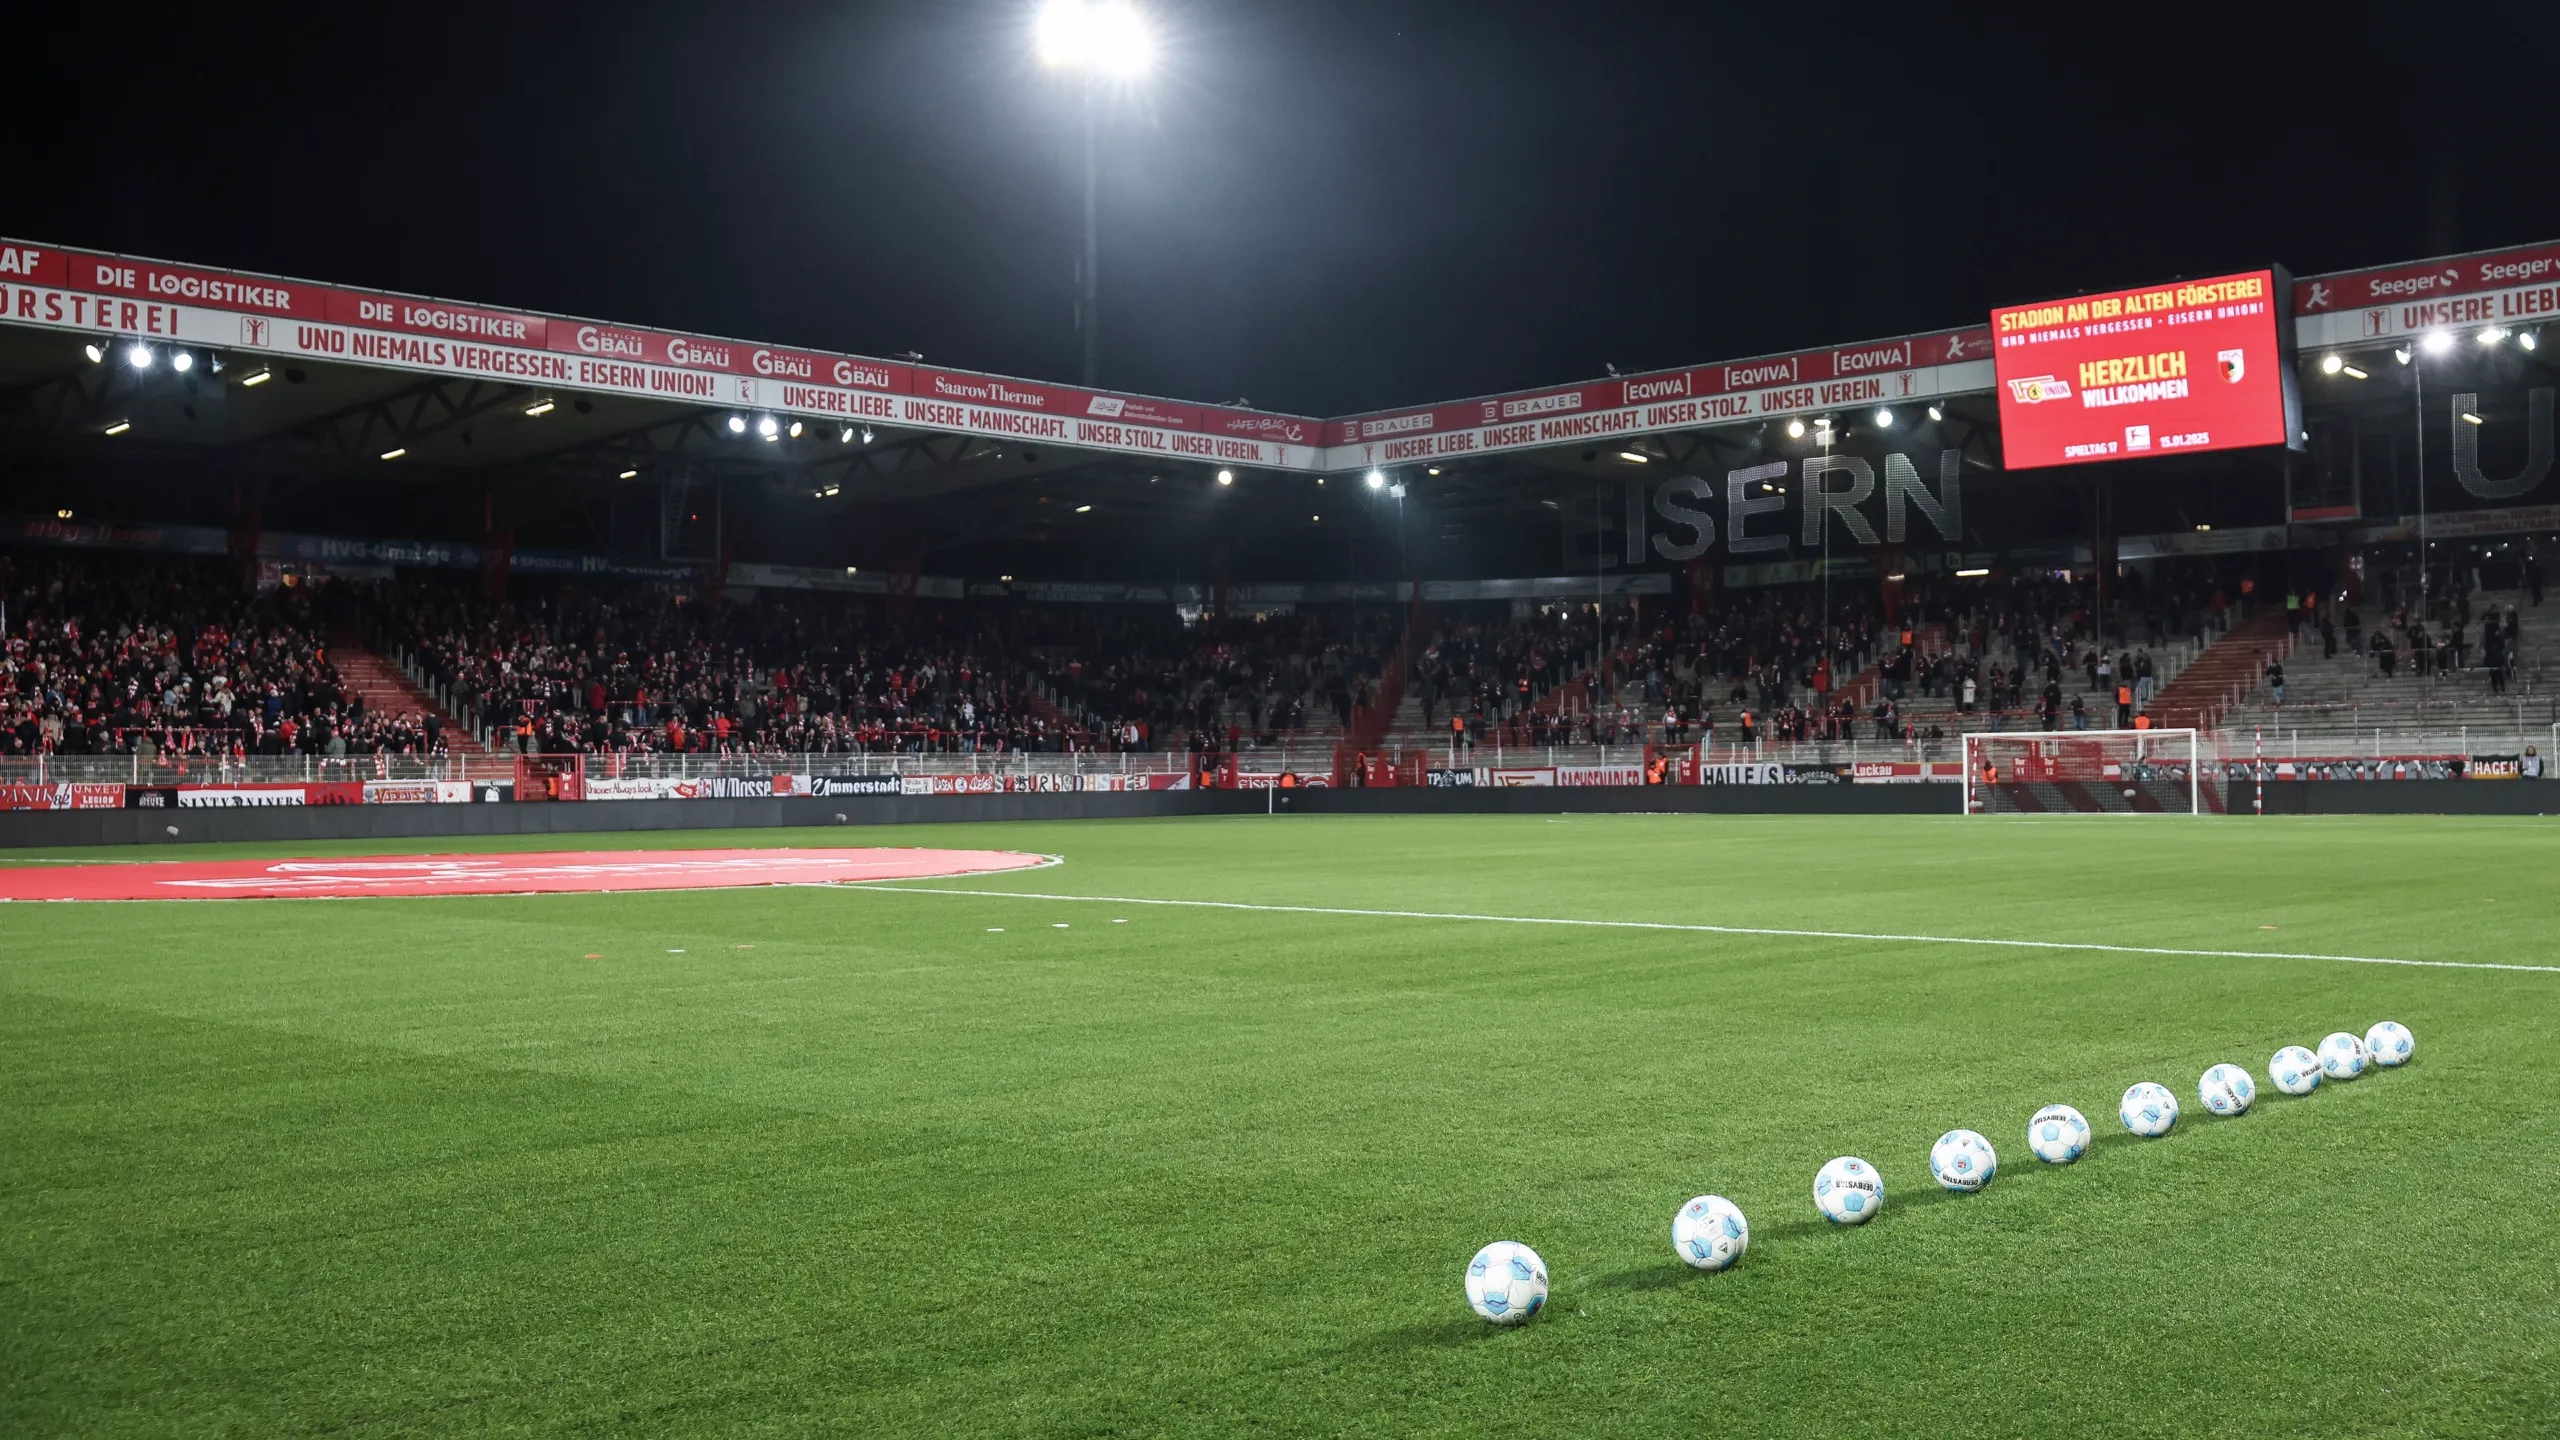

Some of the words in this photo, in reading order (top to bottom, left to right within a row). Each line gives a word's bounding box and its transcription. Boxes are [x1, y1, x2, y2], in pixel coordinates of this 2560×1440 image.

[2481, 258, 2552, 282] Seeger
[96, 265, 136, 289] DIE
[148, 272, 291, 310] LOGISTIKER
[2370, 275, 2437, 297] Seeger
[2000, 307, 2063, 332] STADION
[2067, 302, 2089, 323] AN
[2092, 297, 2122, 319] DER
[2125, 291, 2174, 315] ALTEN
[2177, 278, 2263, 307] FÖRSTEREI
[2404, 296, 2494, 330] UNSERE
[360, 301, 393, 322] DIE
[404, 307, 526, 340] LOGISTIKER
[2002, 335, 2025, 347] UND
[2030, 328, 2080, 344] NIEMALS
[2085, 317, 2152, 337] VERGESSEN
[2168, 308, 2213, 326] EISERN
[2218, 302, 2264, 320] UNION!
[298, 325, 345, 353] UND
[352, 332, 446, 366] NIEMALS
[452, 345, 573, 380] VERGESSEN:
[580, 361, 645, 388] EISERN
[652, 370, 714, 396] UNION!
[2079, 351, 2187, 388] HERZLICH
[936, 376, 1044, 406] SaarowTherme
[2082, 378, 2189, 408] WILLKOMMEN
[1505, 395, 1580, 415] BRAUER
[784, 386, 847, 411] UNSERE
[851, 394, 898, 418] LIEBE.
[905, 401, 963, 426] UNSERE
[970, 409, 1067, 438] MANNSCHAFT.
[1078, 423, 1121, 445] UNSER
[1126, 430, 1167, 450] STOLZ.
[1172, 434, 1213, 455] UNSER
[1216, 440, 1263, 461] VEREIN.
[1364, 415, 1432, 433] BRAUER
[1385, 437, 1433, 460] UNSERE
[1438, 432, 1478, 453] LIEBE.
[1484, 424, 1535, 447] UNSERE
[1541, 410, 1642, 440] MANNSCHAFT.
[1648, 403, 1696, 426] UNSER
[1701, 395, 1752, 419] STOLZ.
[1762, 389, 1814, 412] UNSER
[1820, 378, 1885, 404] VEREIN.
[2065, 443, 2107, 458] SPIELTAG
[2108, 442, 2118, 453] 17
[2160, 432, 2209, 448] 15.01.2025
[1562, 450, 1961, 571] EISERN
[1854, 764, 1892, 777] Luckau
[2015, 757, 2026, 766] Tor
[2044, 757, 2054, 766] Tor
[2045, 767, 2054, 775] 12
[561, 773, 572, 781] Tor
[586, 782, 611, 794] Unioner
[1836, 1180, 1873, 1192] DERBYSTAR
[1942, 1173, 1979, 1186] DERBYSTAR
